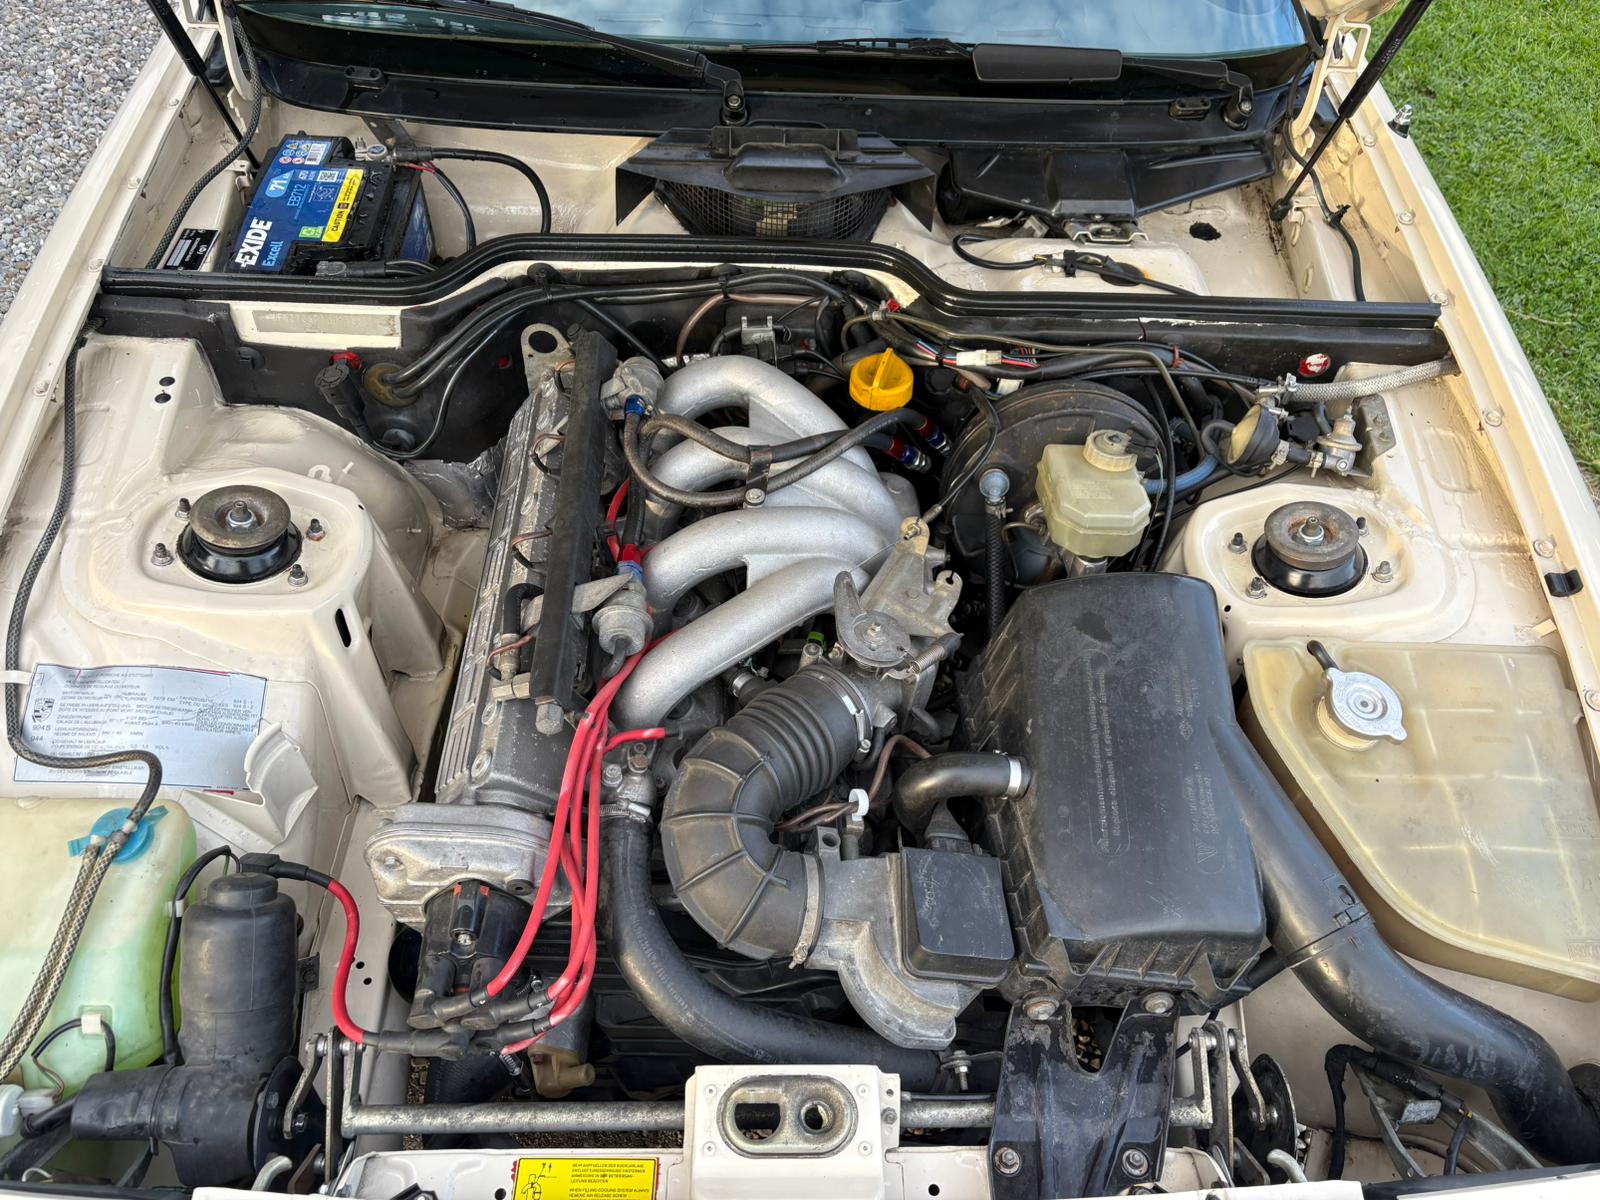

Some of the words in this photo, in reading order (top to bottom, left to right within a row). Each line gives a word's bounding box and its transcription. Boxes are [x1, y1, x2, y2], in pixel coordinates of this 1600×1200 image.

[270, 176, 286, 192] 71
[287, 183, 308, 207] EB712
[331, 210, 345, 232] CAUTION
[234, 217, 272, 268] EXIDE
[262, 240, 284, 267] Excell
